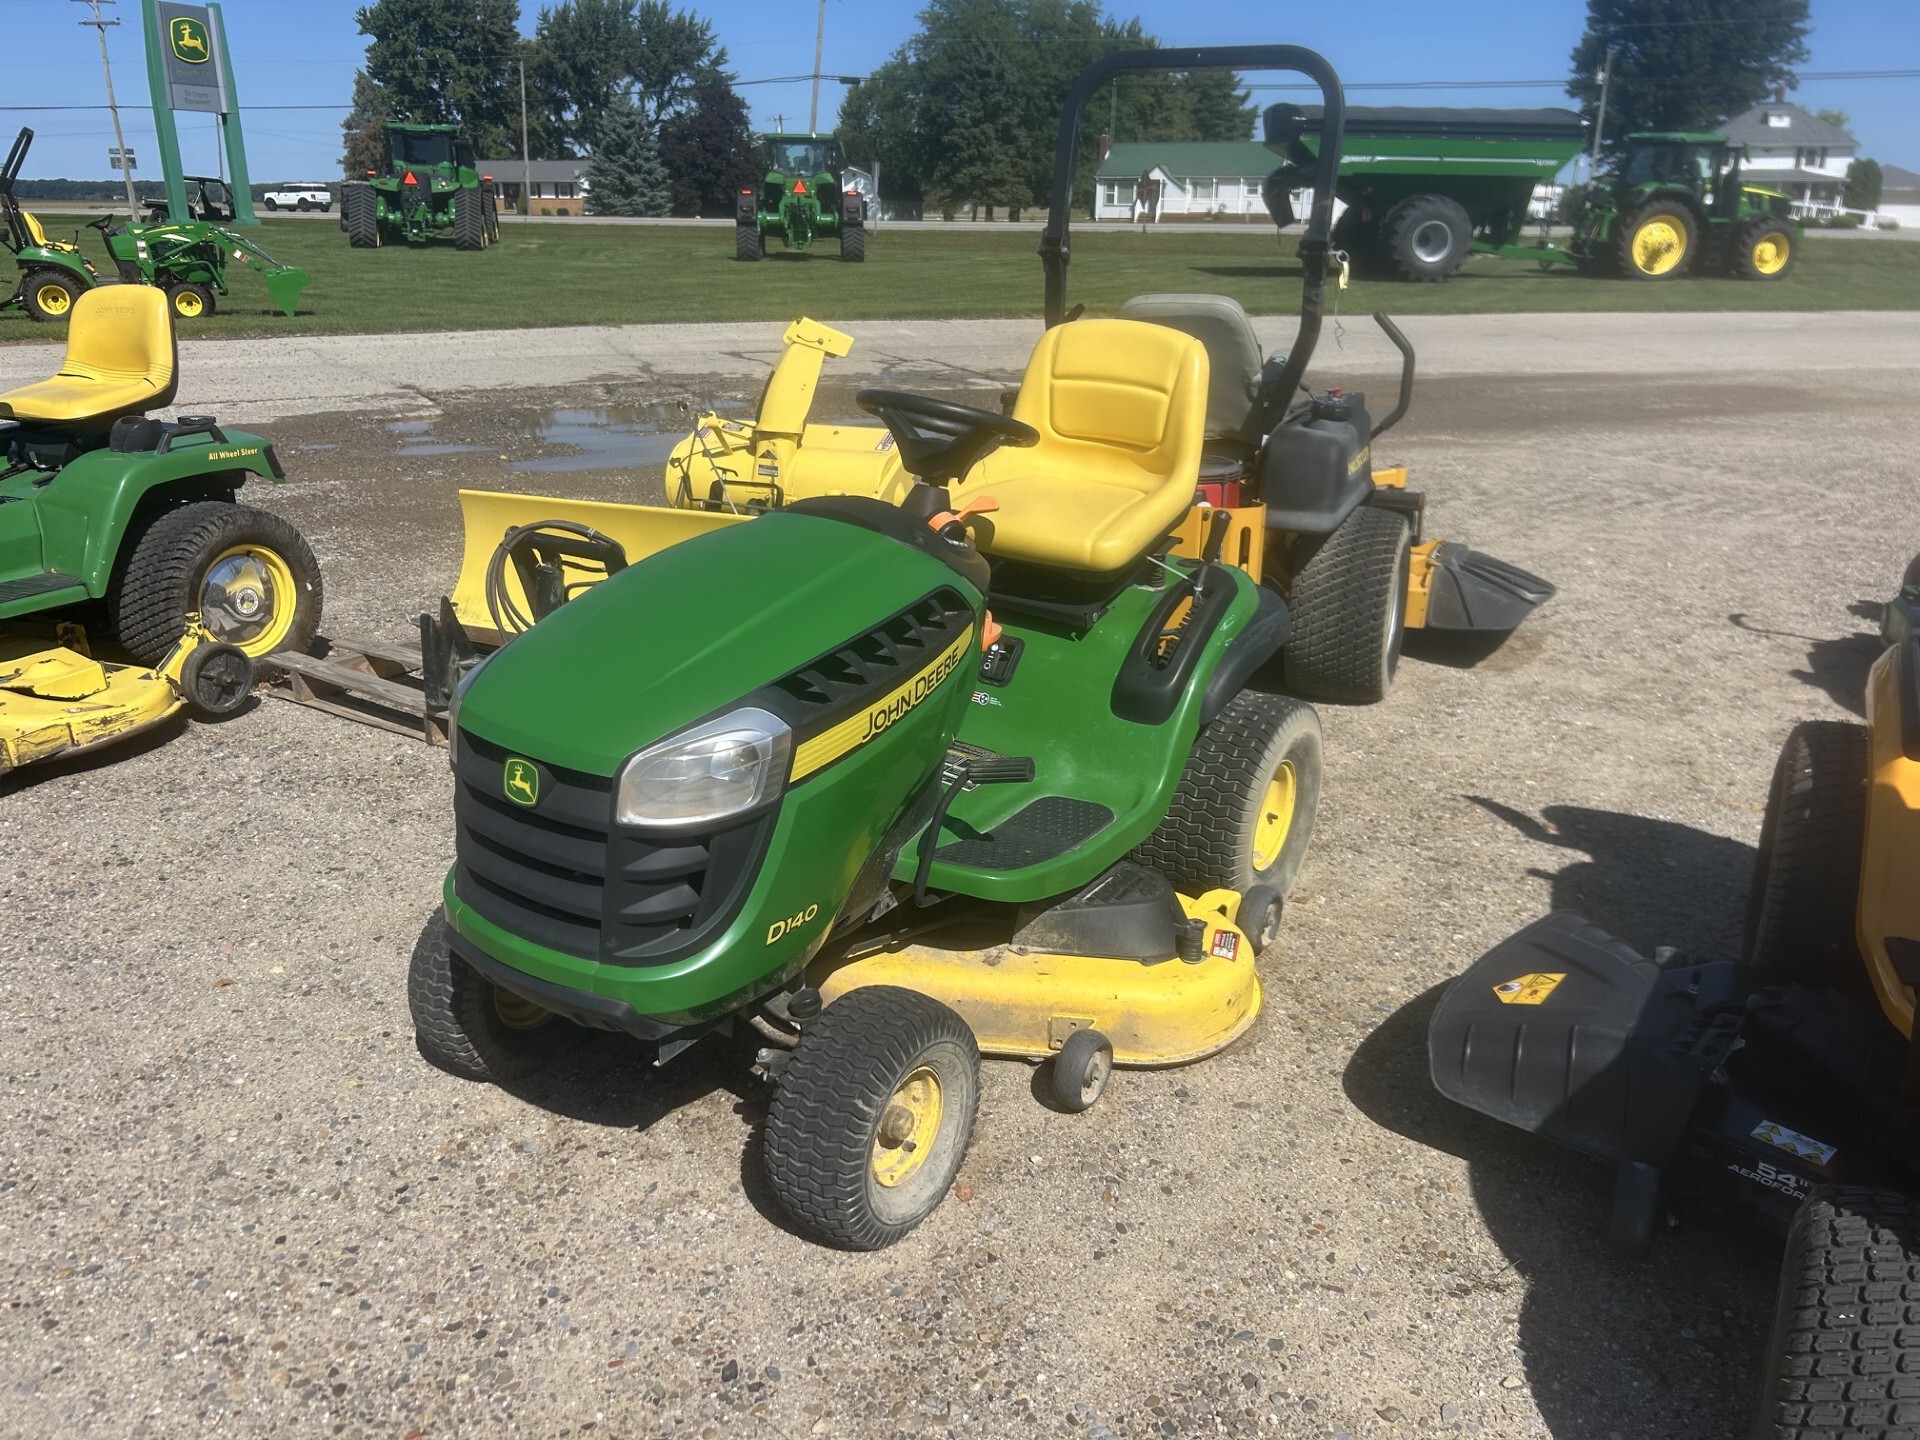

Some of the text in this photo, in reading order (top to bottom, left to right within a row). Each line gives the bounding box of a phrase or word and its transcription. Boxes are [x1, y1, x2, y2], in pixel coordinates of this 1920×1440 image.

[208, 448, 258, 460] All Wheel Steer
[862, 646, 960, 742] JOHN DEERE
[766, 903, 818, 946] D140
[1727, 1163, 1807, 1201] AEROFOR
